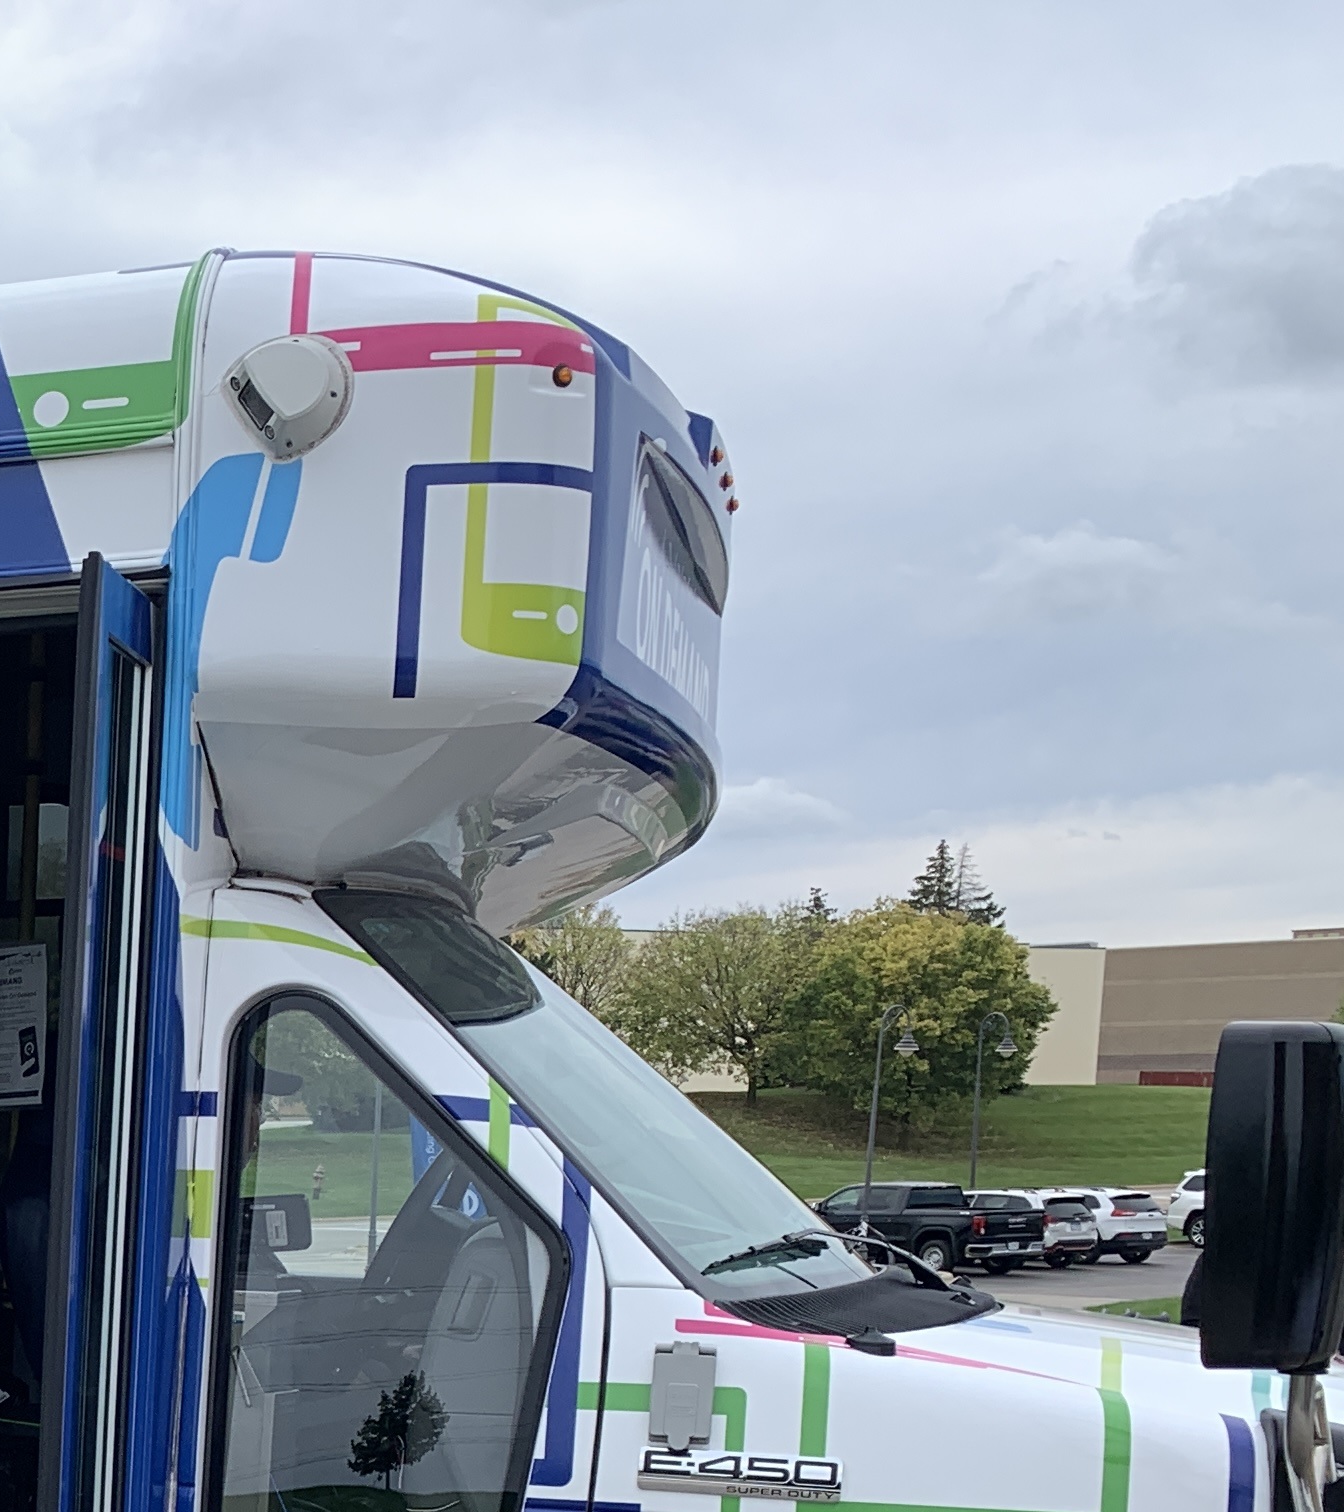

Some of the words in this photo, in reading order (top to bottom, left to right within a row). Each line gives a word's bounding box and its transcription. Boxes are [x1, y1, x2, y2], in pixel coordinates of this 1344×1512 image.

[636, 547, 663, 671] ON
[725, 1484, 782, 1497] SUPER
[787, 1488, 836, 1501] DUTY
